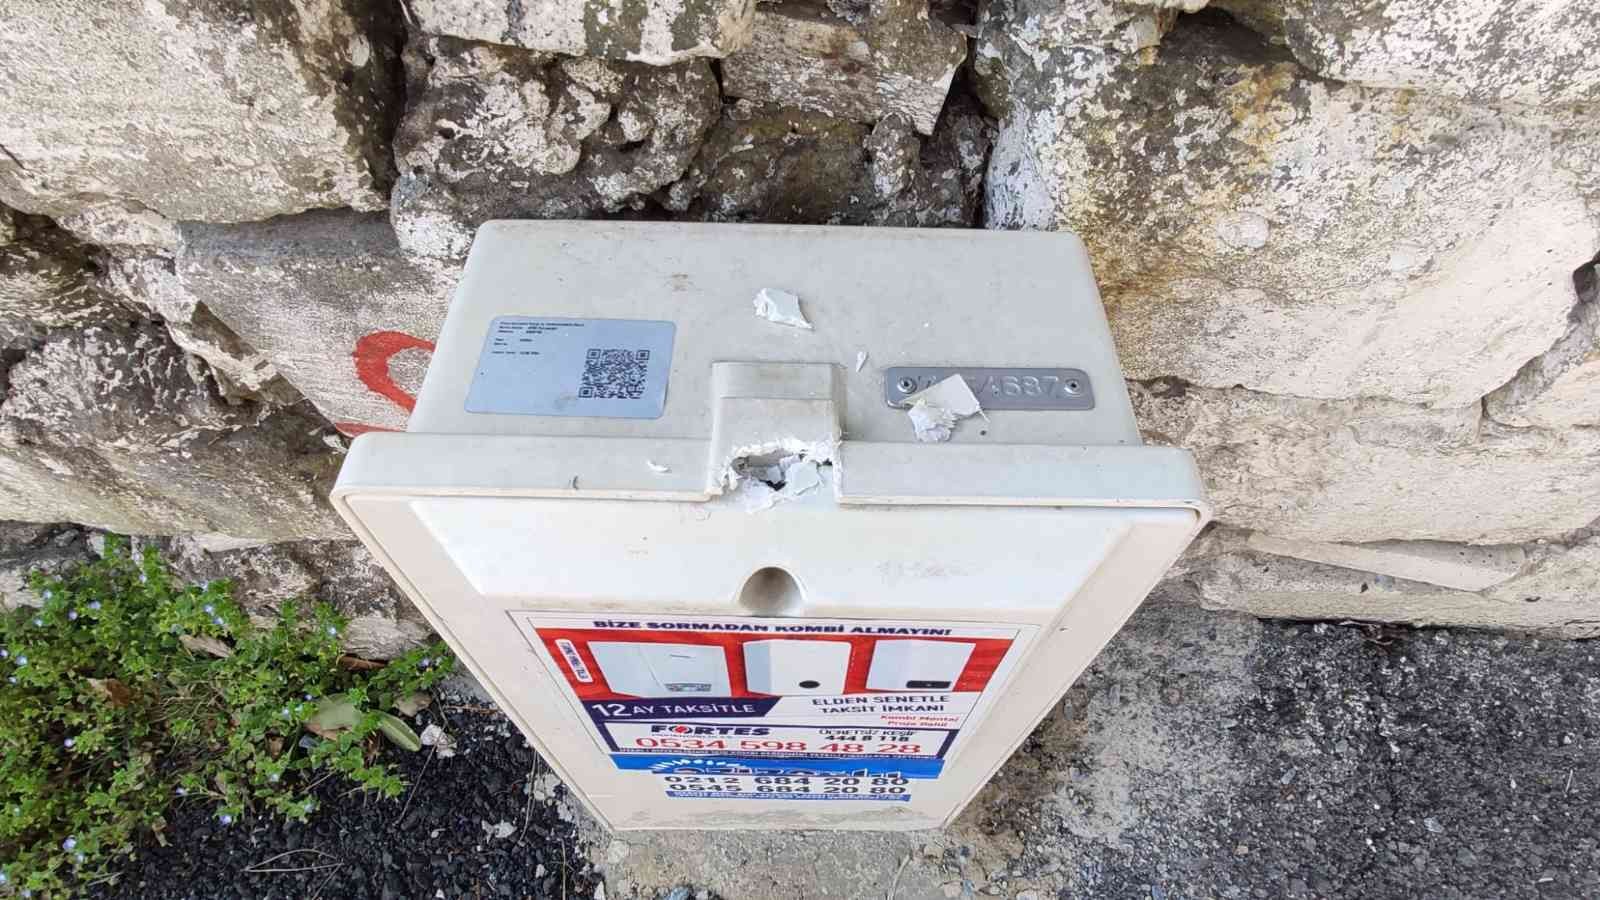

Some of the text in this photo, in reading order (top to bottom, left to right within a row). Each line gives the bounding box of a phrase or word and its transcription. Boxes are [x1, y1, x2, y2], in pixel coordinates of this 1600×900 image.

[593, 620, 641, 628] BİZE
[647, 622, 769, 632] SORMADAN
[775, 624, 844, 633] KOMBİ
[812, 695, 950, 706] ELDEN SENETLE
[592, 703, 755, 717] 12 AY TAKSİTLE
[820, 704, 944, 714] TAKSİT İMKANI
[651, 724, 771, 736] FORTES
[635, 737, 729, 750] 0534
[740, 740, 807, 751] 598
[819, 742, 865, 753] 48
[878, 743, 921, 754] 28
[664, 776, 908, 786] 0212 684 20 80
[670, 784, 906, 794] 0545 684 20 80
